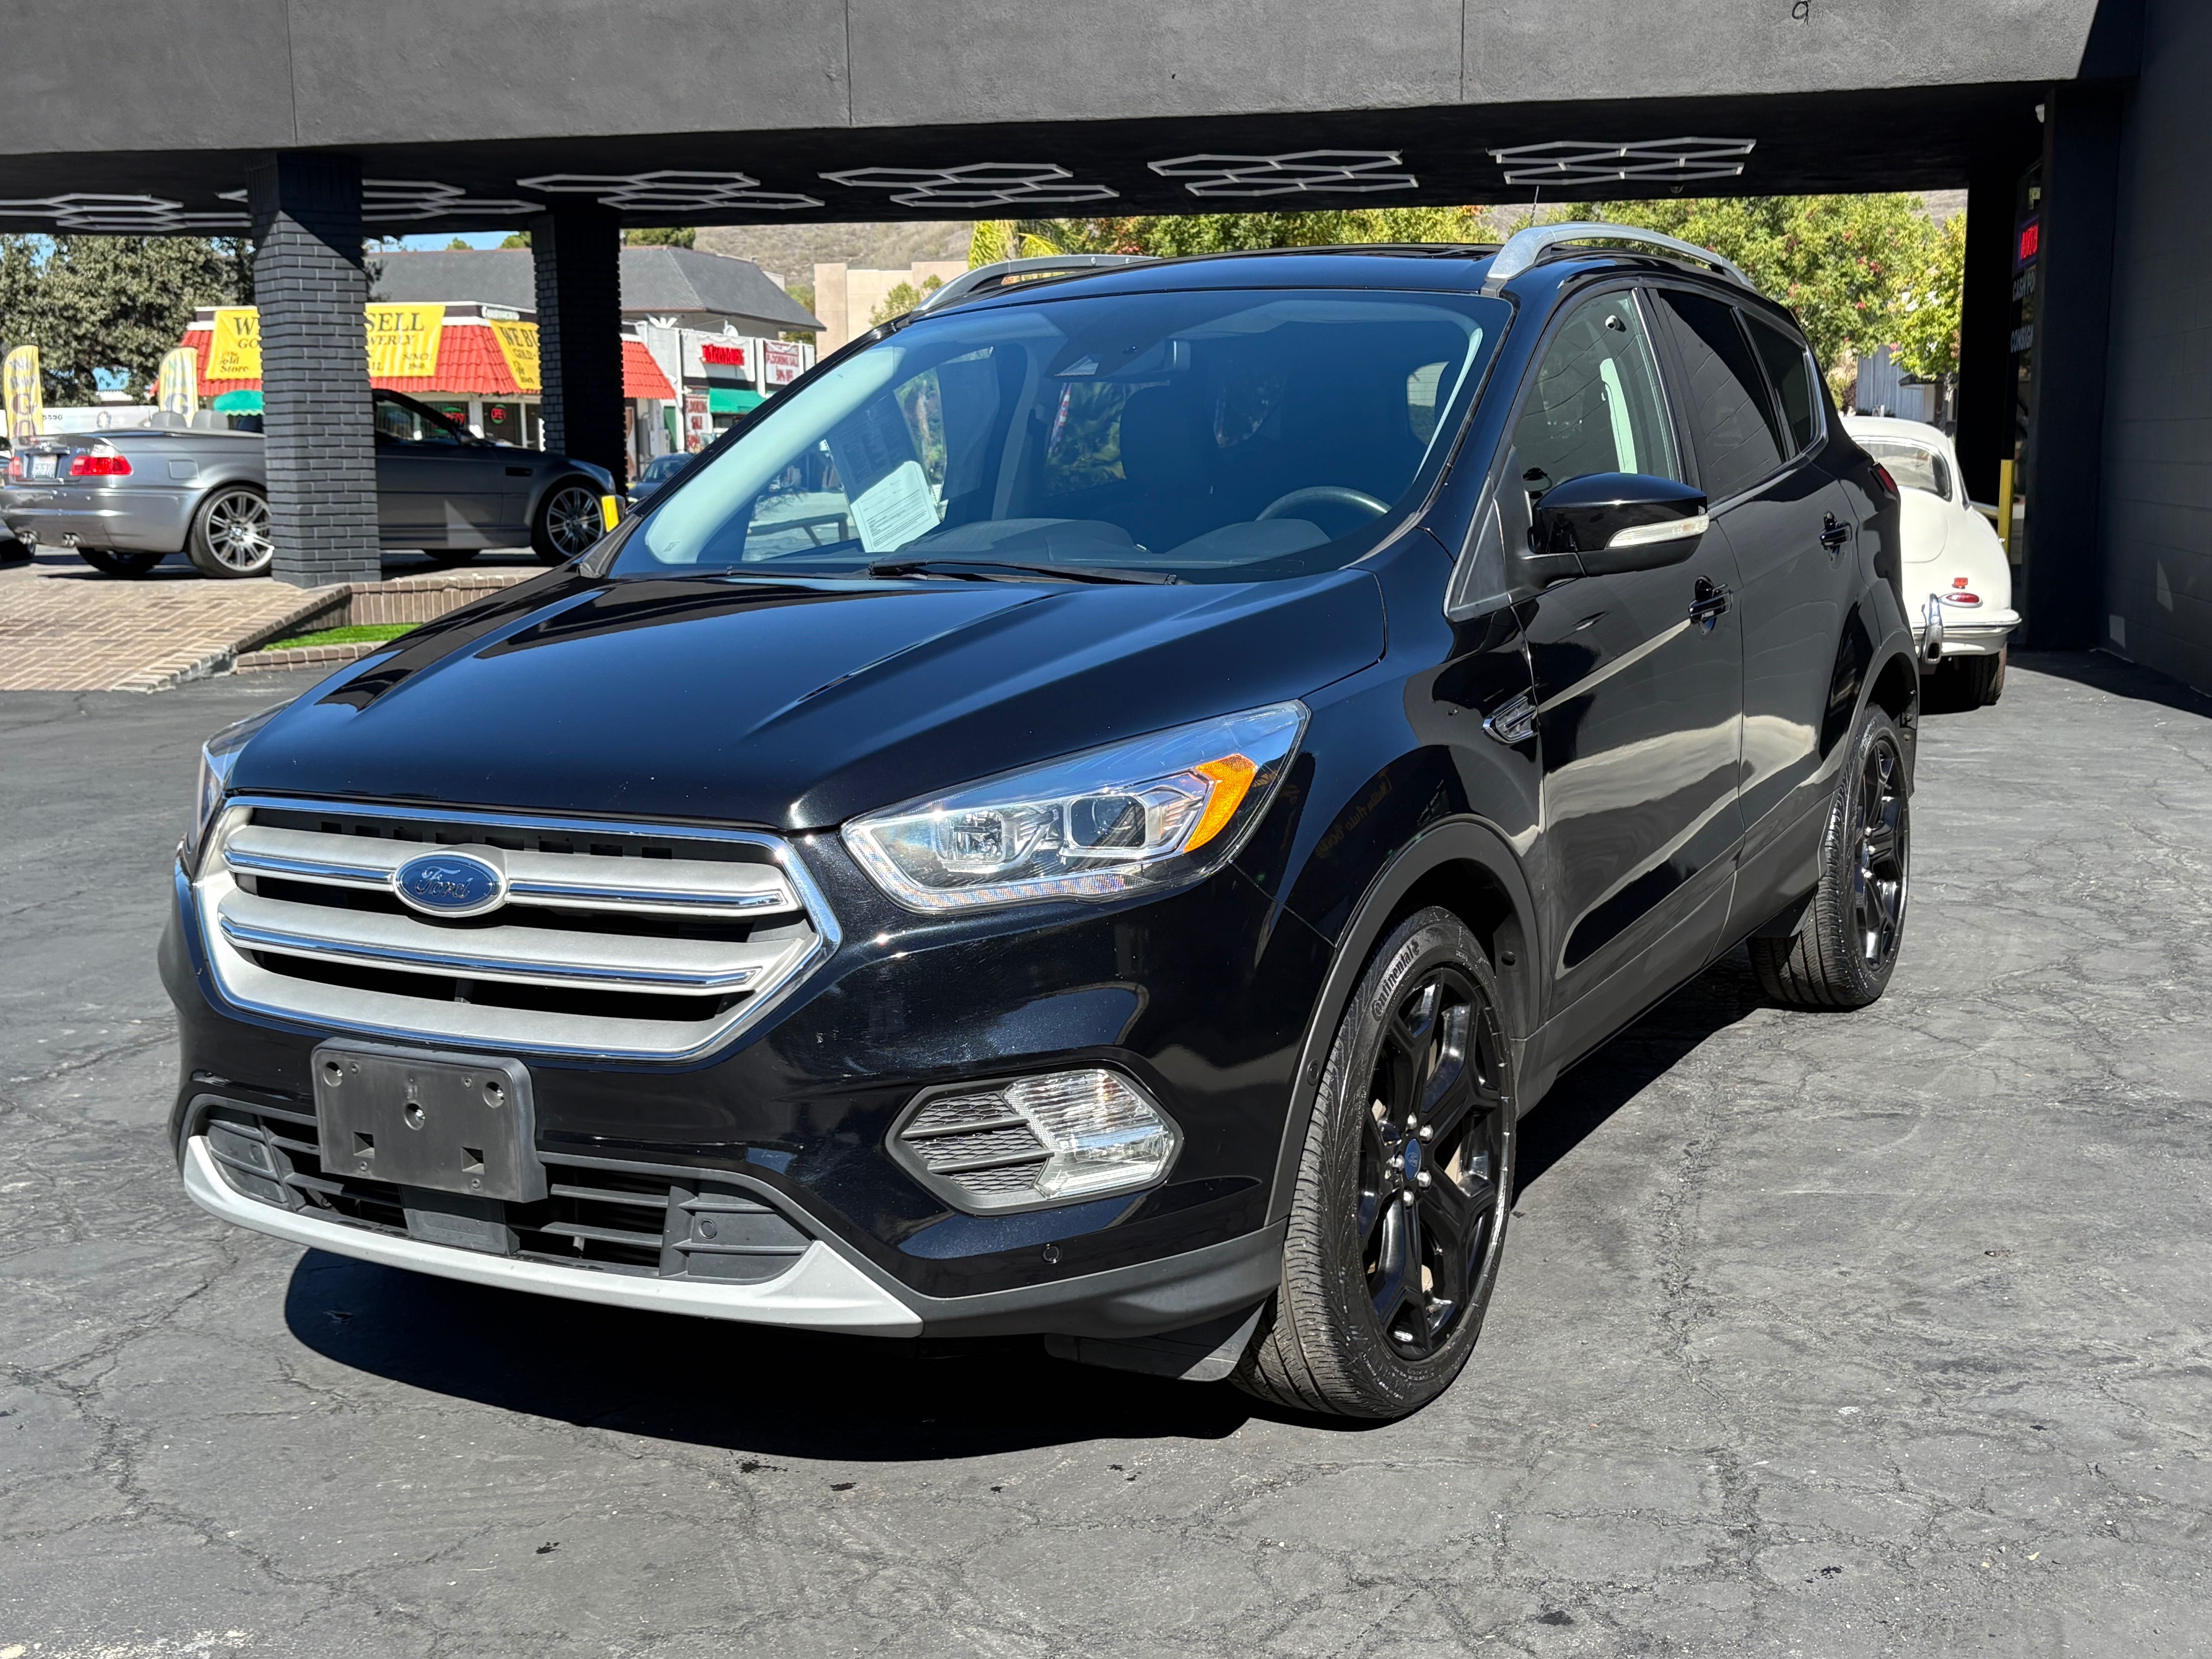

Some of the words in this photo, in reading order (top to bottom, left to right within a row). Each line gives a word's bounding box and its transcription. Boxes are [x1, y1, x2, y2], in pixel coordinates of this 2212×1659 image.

[2012, 275, 2026, 302] CASH
[366, 312, 425, 332] SELL
[499, 326, 523, 346] WE
[414, 865, 474, 899] Ford
[1371, 945, 1414, 1022] Continental
